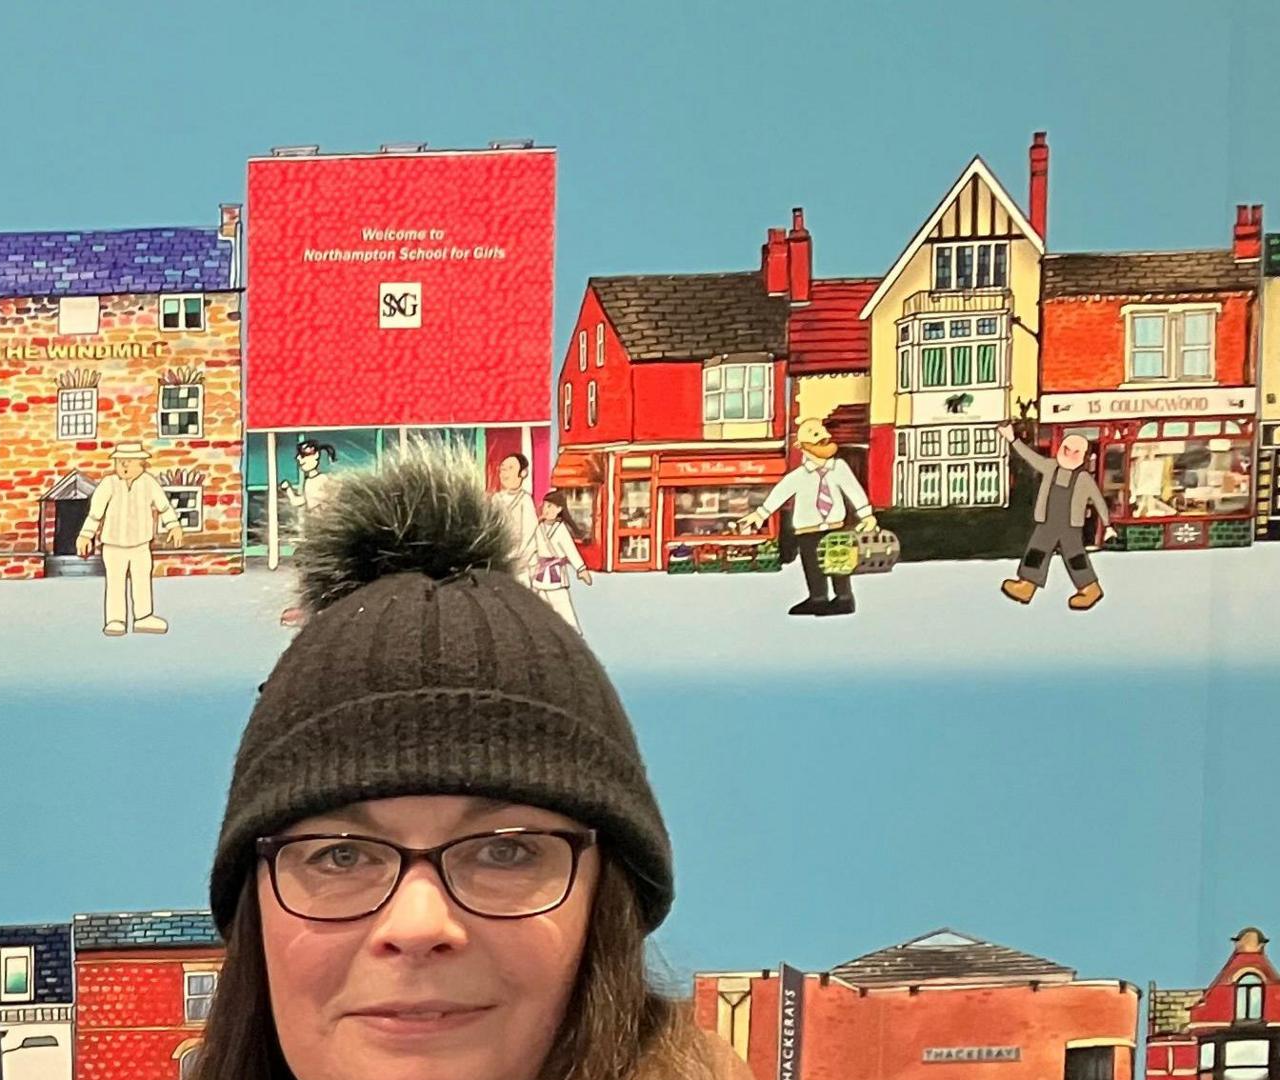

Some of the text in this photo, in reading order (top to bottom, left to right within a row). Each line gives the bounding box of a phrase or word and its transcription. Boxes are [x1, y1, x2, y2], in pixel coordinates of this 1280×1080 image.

[361, 228, 445, 241] Welcome to
[303, 247, 506, 263] Northampton School for Girls
[1088, 396, 1208, 414] 15 COLLINGWOOD
